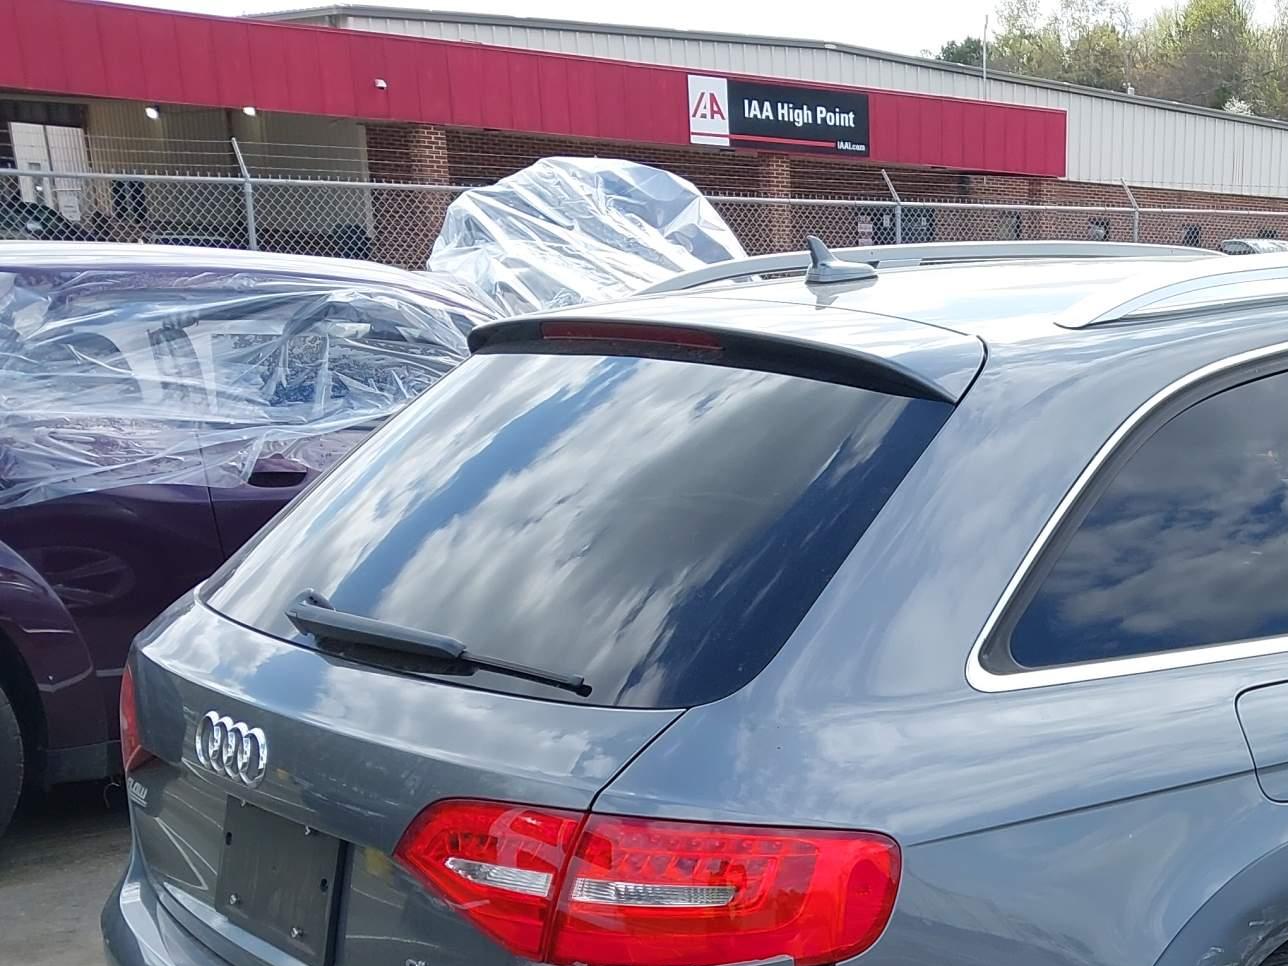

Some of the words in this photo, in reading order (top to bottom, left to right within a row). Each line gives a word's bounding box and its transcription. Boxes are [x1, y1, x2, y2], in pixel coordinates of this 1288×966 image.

[744, 98, 774, 121] IAA
[777, 102, 813, 127] High
[817, 106, 856, 128] Point
